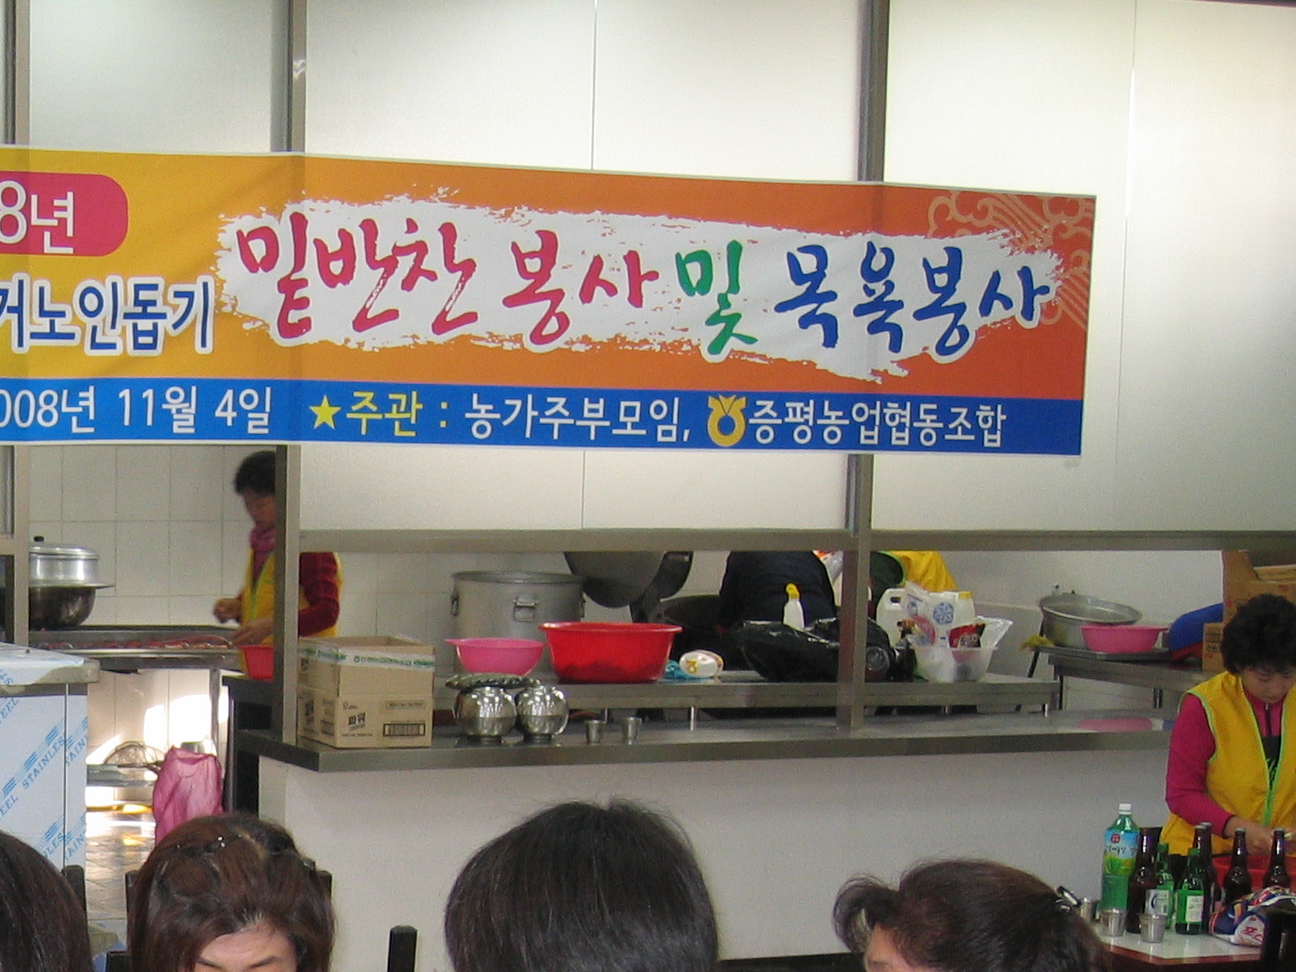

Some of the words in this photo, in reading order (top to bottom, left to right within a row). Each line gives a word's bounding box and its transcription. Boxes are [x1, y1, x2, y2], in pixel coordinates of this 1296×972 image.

[235, 211, 479, 340] 밑반찬
[501, 229, 660, 346] 봉사
[674, 239, 759, 356] 및
[773, 241, 1051, 356] 목욕봉사
[117, 385, 198, 434] 11월
[214, 386, 272, 435] 4일
[345, 390, 423, 438] 주관
[464, 393, 691, 443] 농가주부모임,
[747, 399, 1007, 448] 증평농업협동조합
